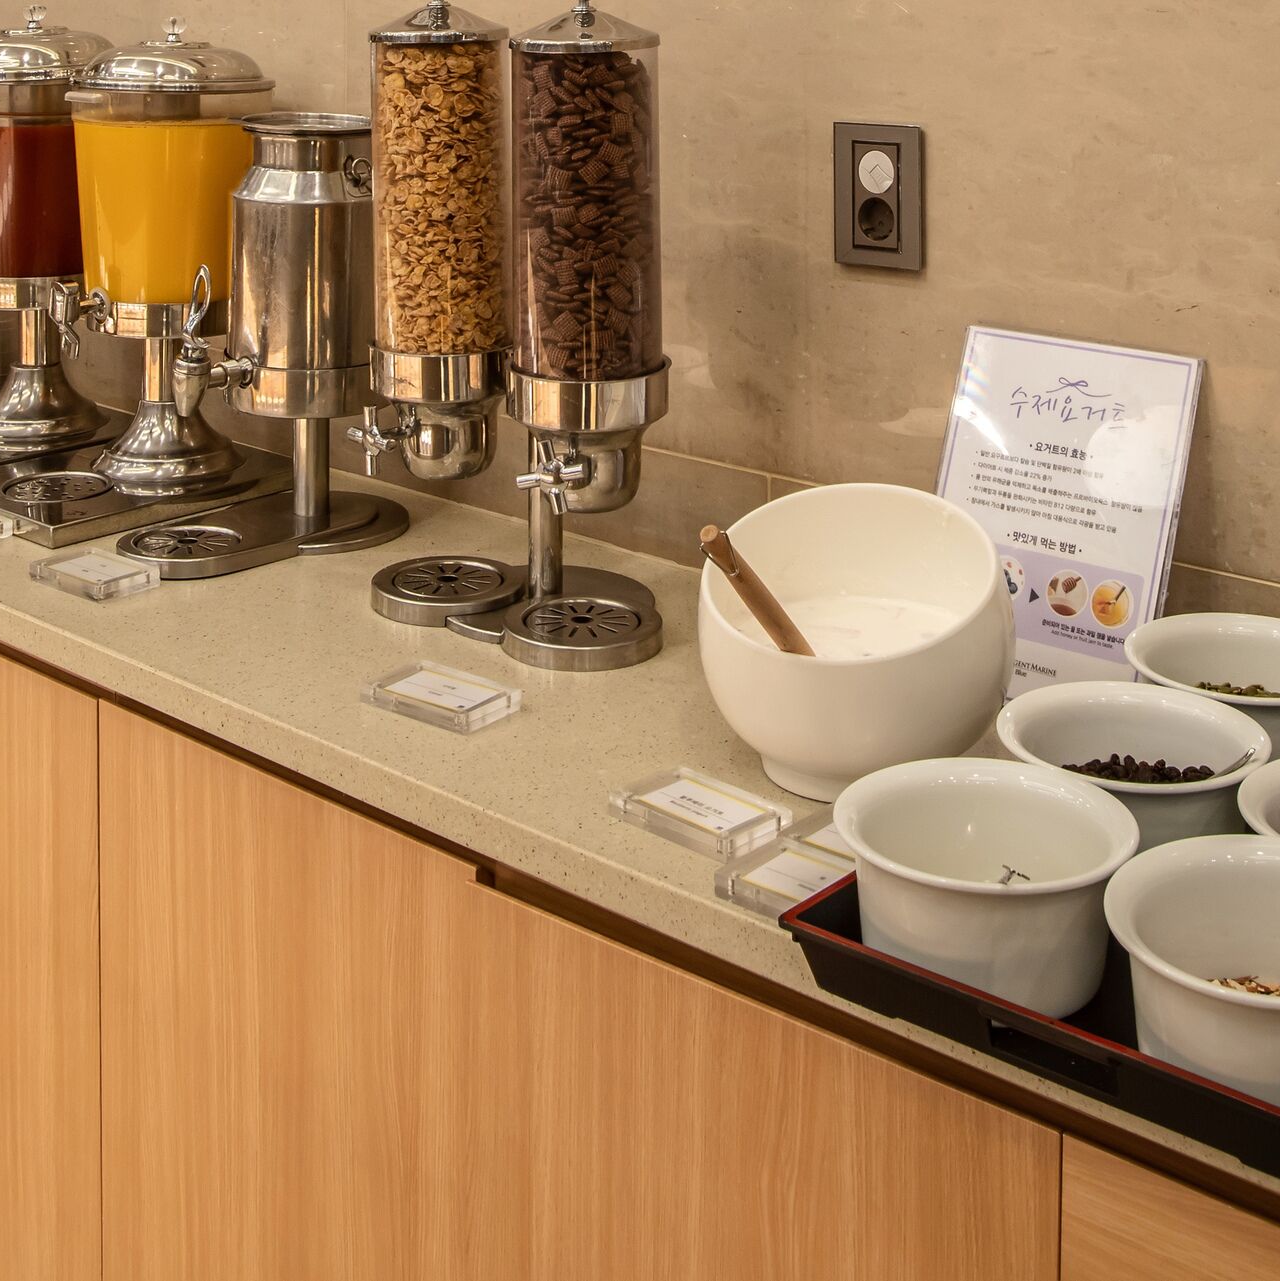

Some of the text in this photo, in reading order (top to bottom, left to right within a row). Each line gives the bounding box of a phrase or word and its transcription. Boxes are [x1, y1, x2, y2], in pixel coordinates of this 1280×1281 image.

[1034, 441, 1087, 461] 요거트의 효능
[1012, 531, 1077, 554] 맛있게 먹는 방법
[1031, 663, 1057, 677] MARINE
